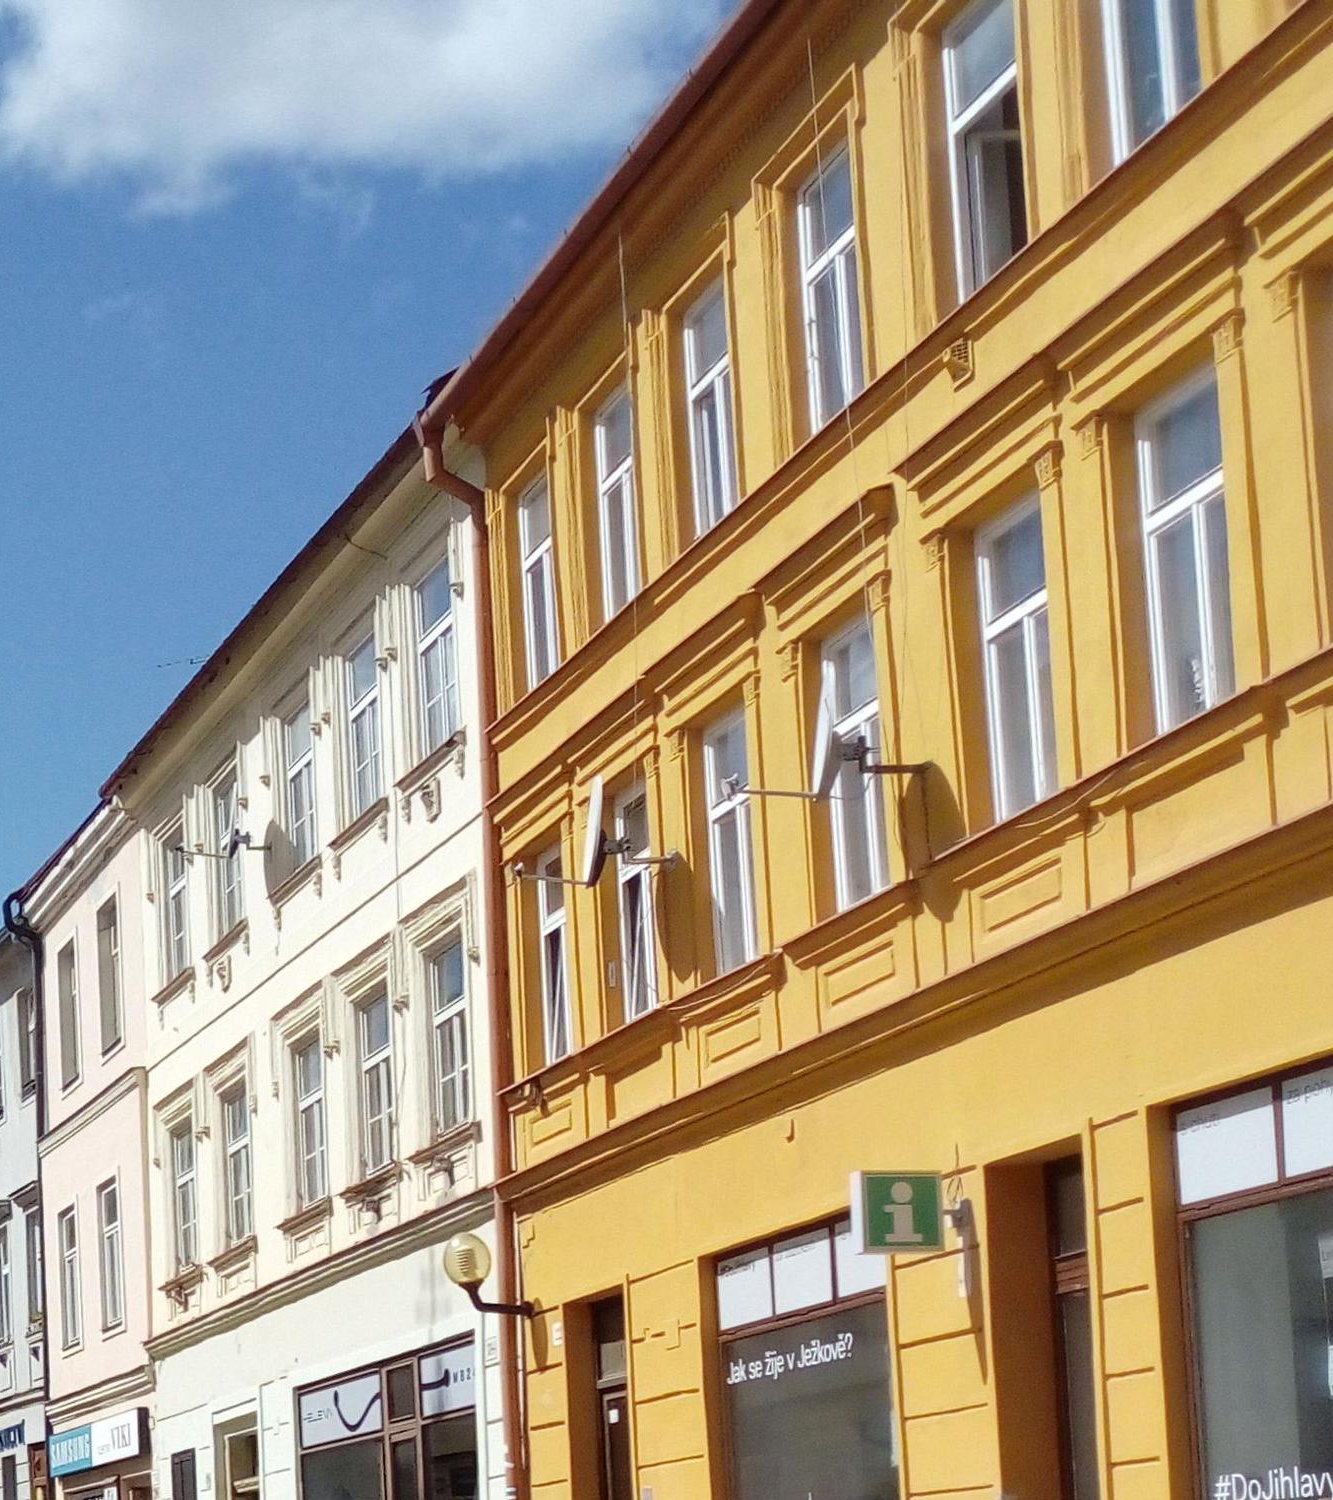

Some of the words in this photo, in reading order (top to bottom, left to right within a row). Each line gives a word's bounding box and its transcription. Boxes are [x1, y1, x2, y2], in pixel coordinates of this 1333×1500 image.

[727, 1358, 747, 1385] Jak
[748, 1360, 763, 1379] se
[786, 1352, 795, 1370] v
[797, 1332, 854, 1368] Ježkově?
[51, 1432, 90, 1470] SAMSUNG
